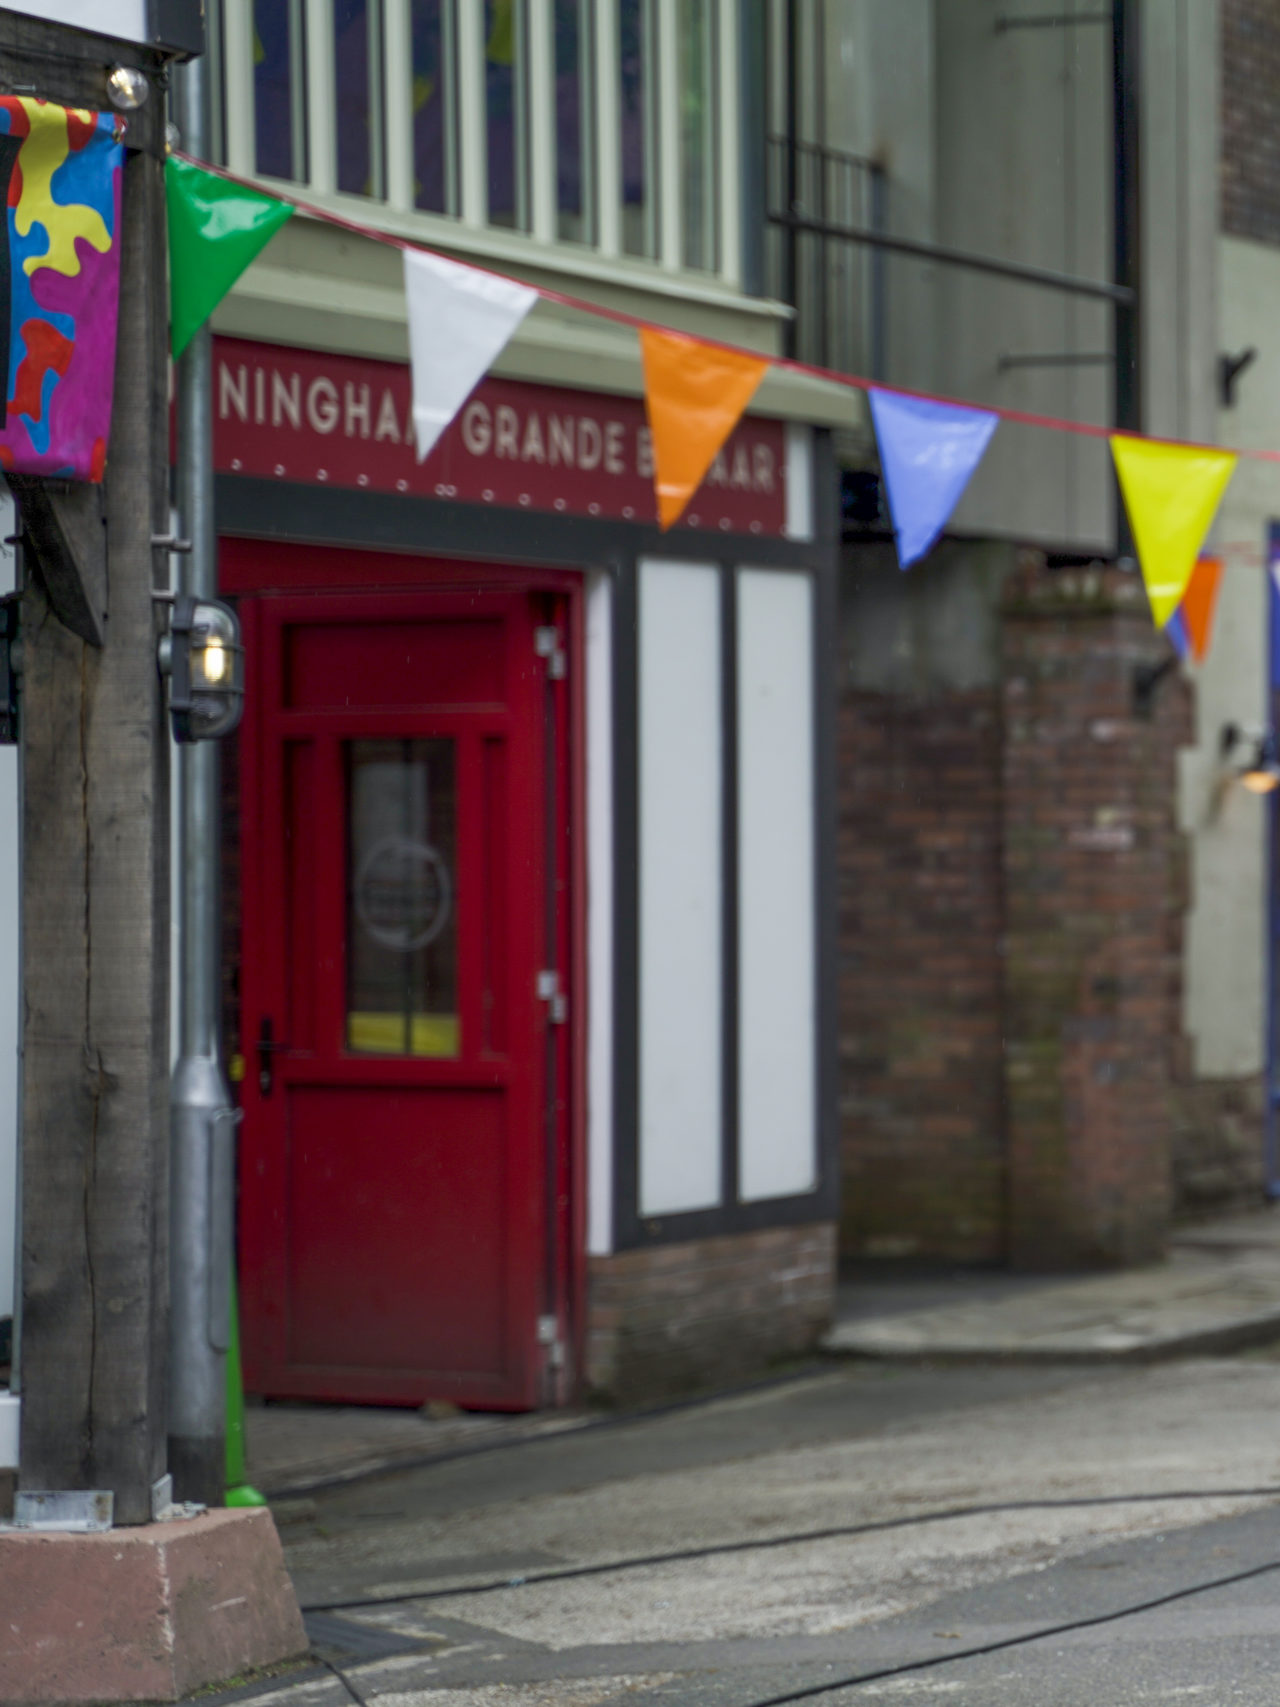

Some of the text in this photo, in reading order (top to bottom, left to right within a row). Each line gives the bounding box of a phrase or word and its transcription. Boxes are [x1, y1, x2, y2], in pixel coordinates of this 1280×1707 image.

[219, 360, 774, 493] NINGHA GRANDE BAAR
